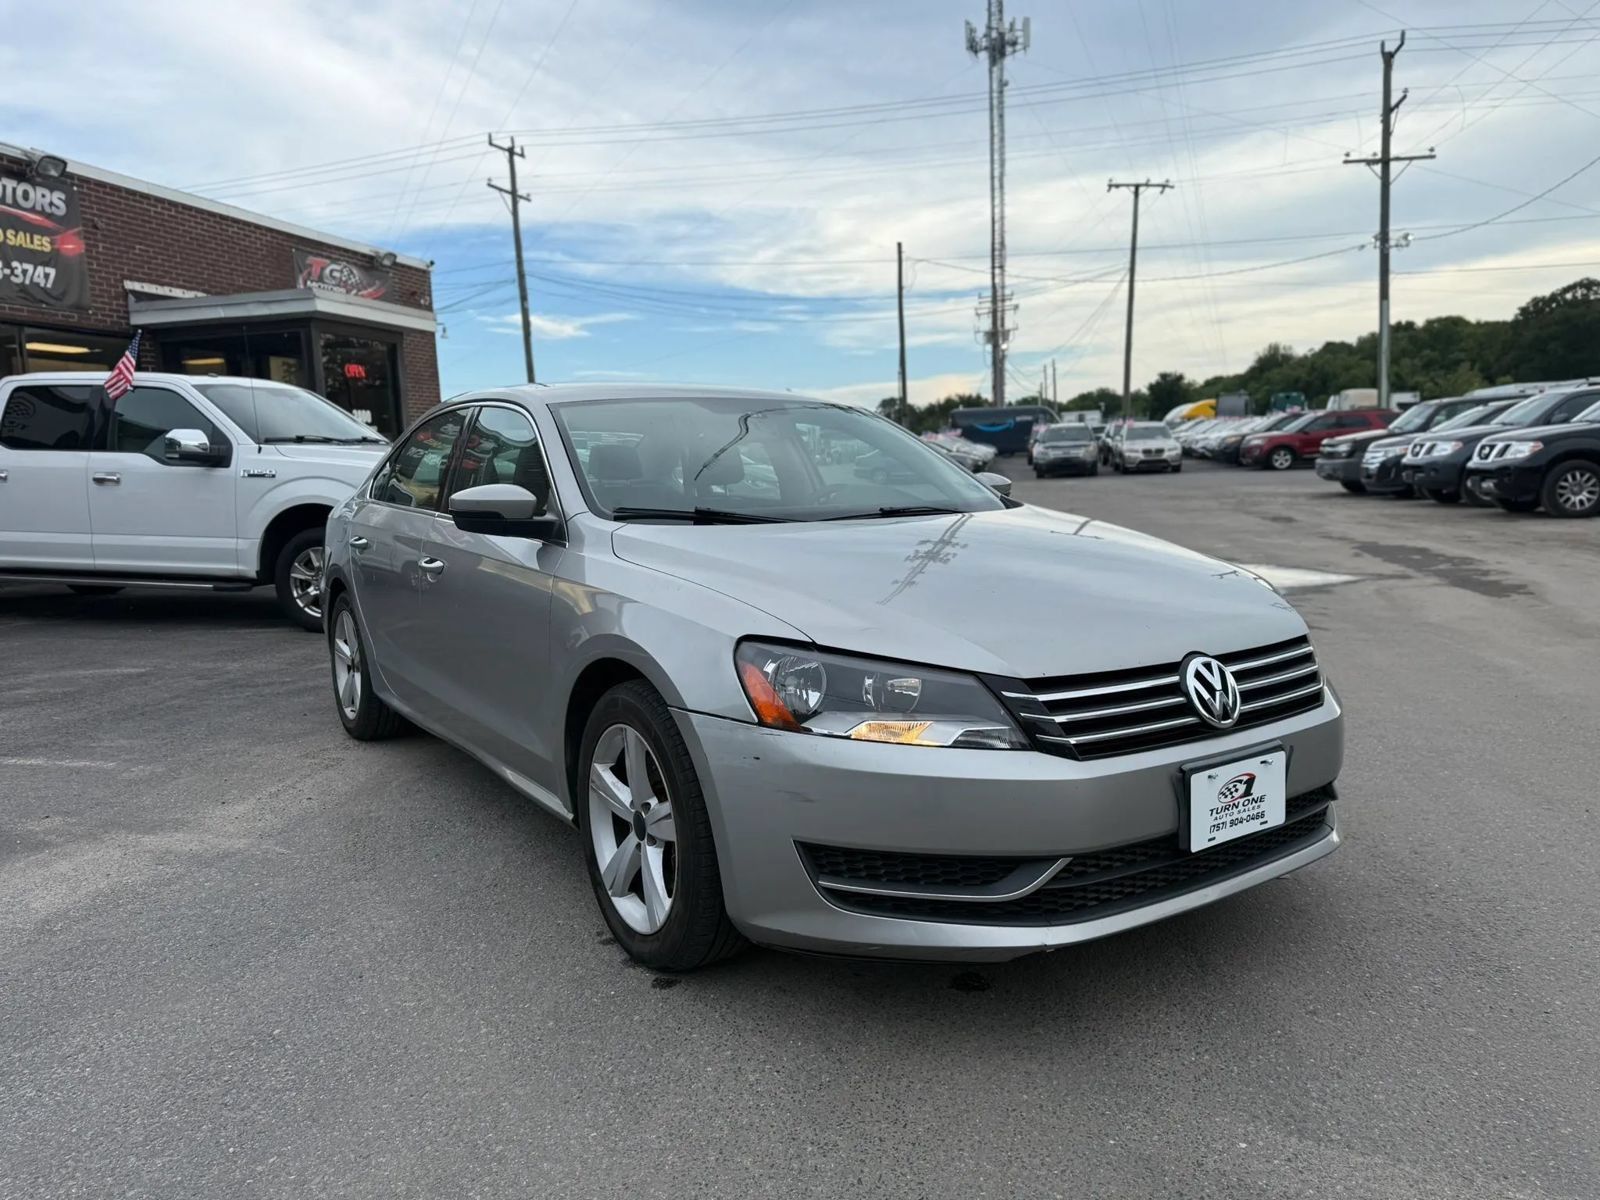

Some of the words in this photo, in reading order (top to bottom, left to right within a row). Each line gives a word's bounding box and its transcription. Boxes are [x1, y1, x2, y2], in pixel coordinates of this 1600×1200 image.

[0, 177, 67, 216] TORS
[6, 229, 52, 252] SALES
[344, 363, 366, 378] OPEN
[1209, 801, 1240, 818] TURN
[1242, 794, 1267, 808] ONE
[1214, 811, 1235, 821] AUTO
[1237, 804, 1261, 814] SALES
[1209, 820, 1228, 835] (757)
[1229, 810, 1266, 828] 904-0466
